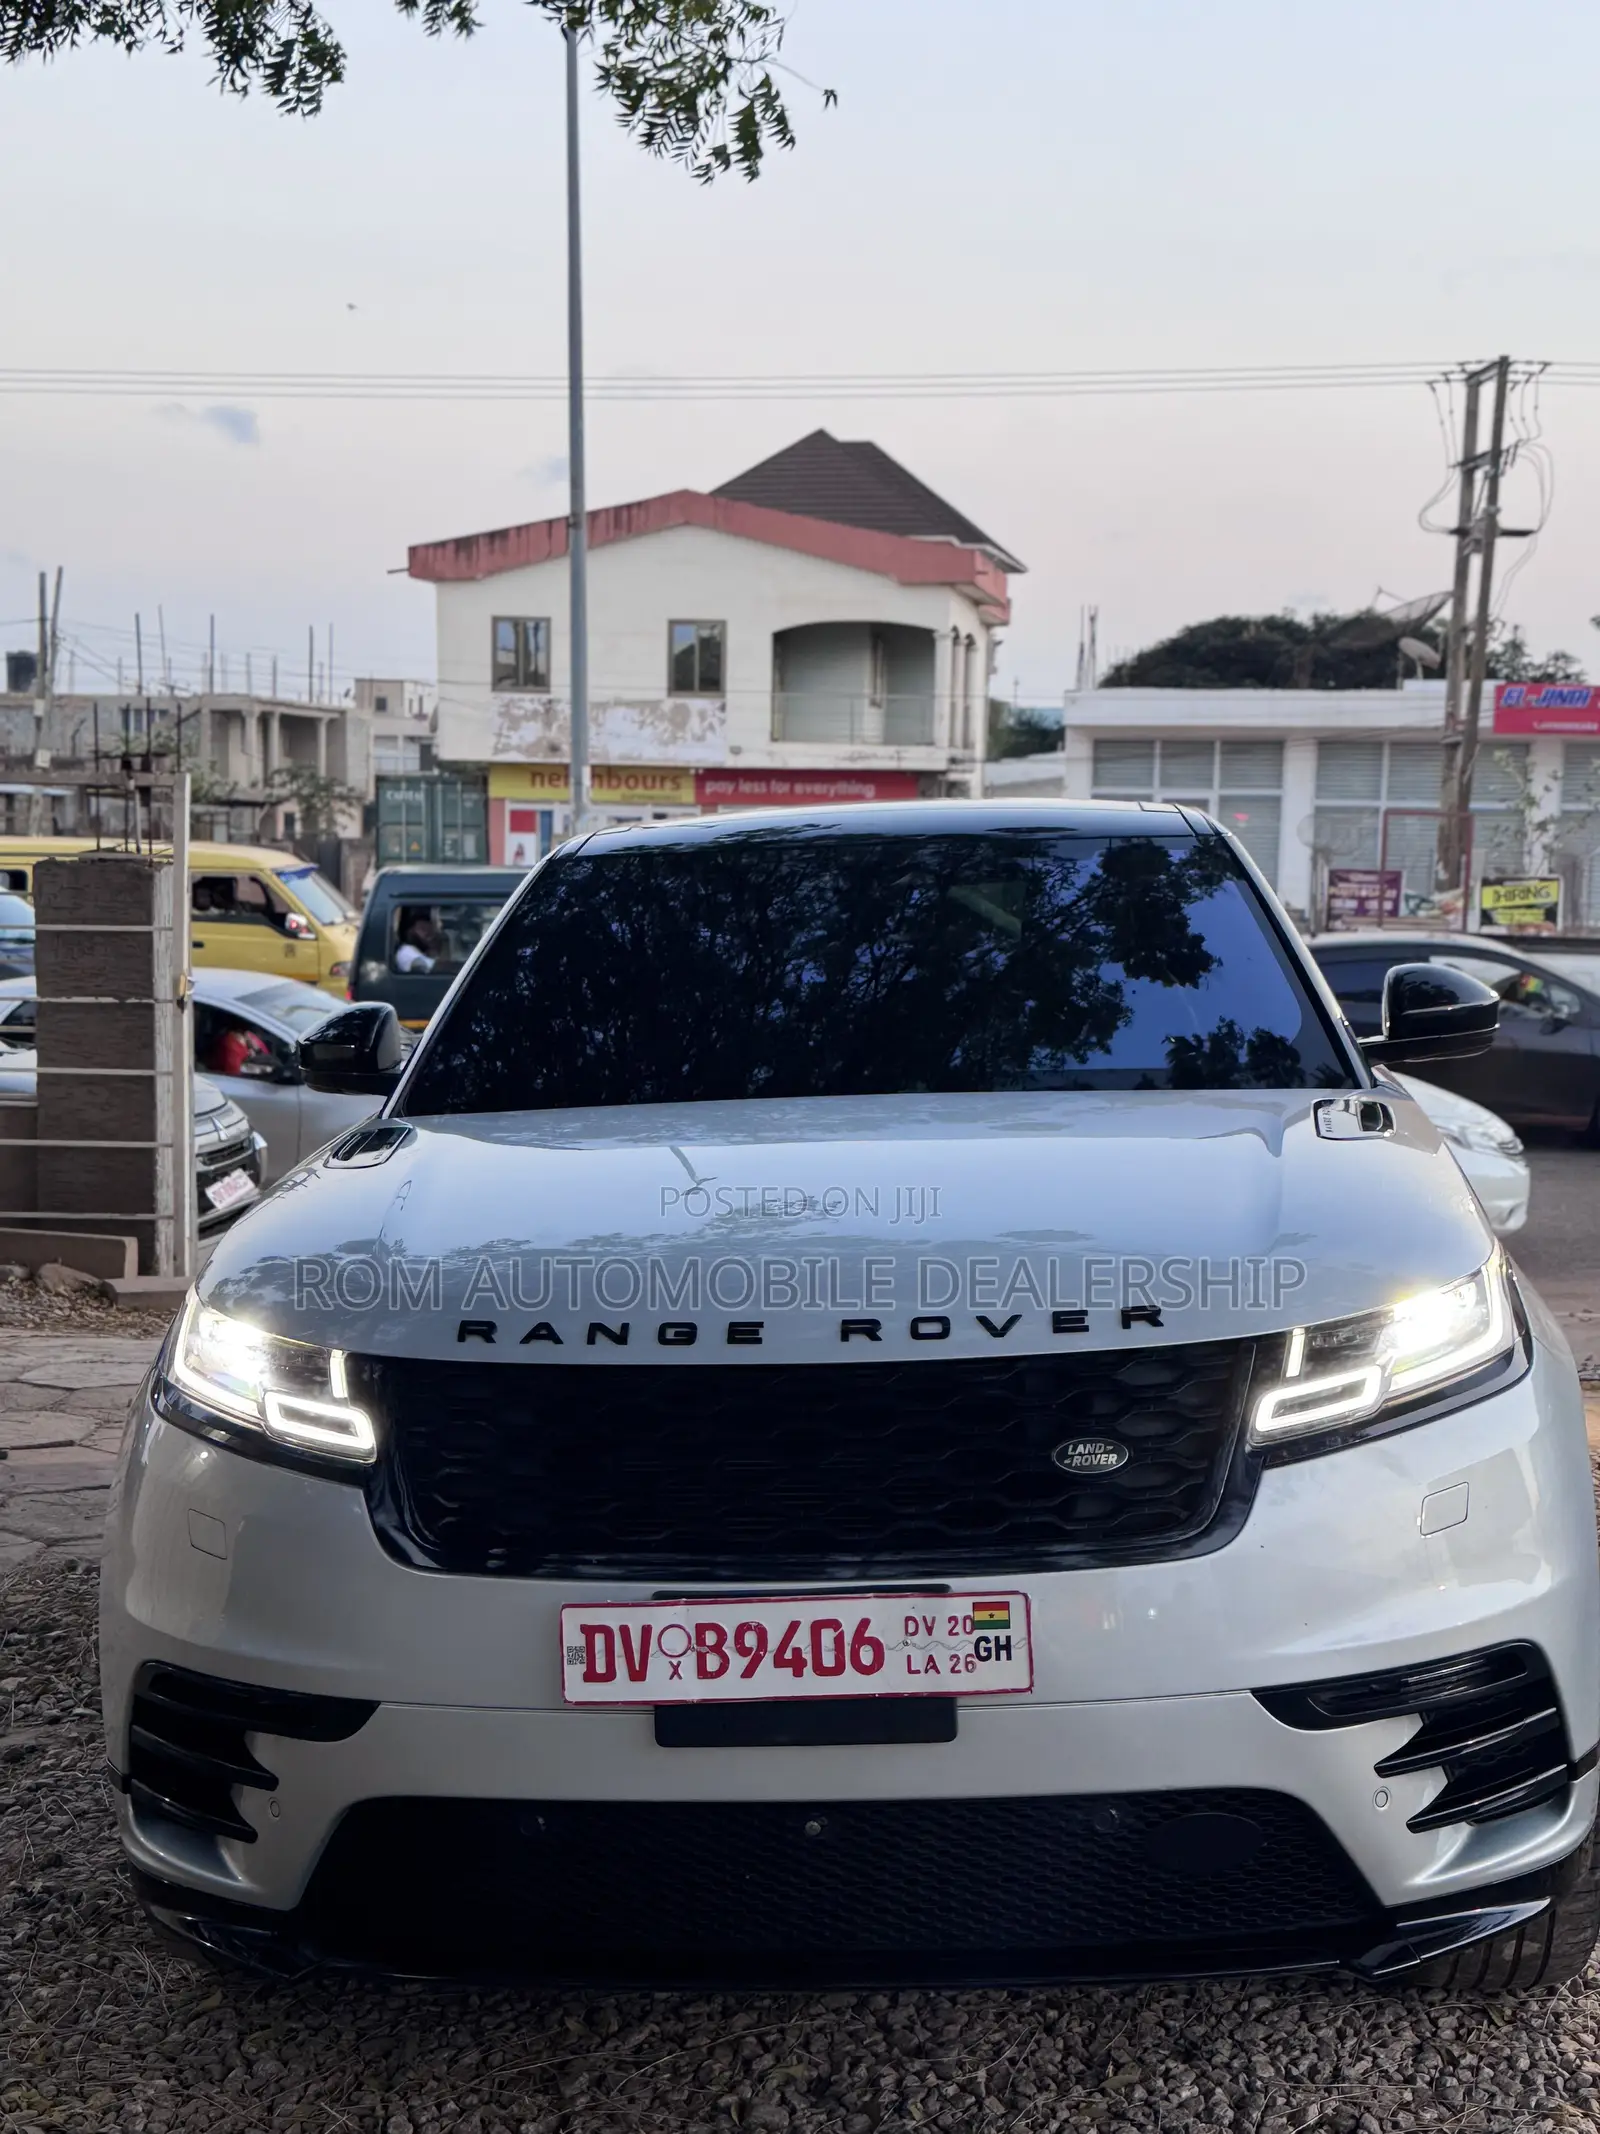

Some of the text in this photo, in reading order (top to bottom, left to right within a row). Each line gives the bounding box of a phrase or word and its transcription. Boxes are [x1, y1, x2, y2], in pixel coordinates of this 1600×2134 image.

[530, 767, 682, 791] neihbours
[705, 778, 876, 799] pay less for everything
[457, 1305, 1165, 1347] RANGE ROVER
[904, 1614, 976, 1637] DV 20
[579, 1617, 885, 1683] DV B9406
[974, 1635, 1012, 1662] GH
[906, 1653, 976, 1675] LA 26
